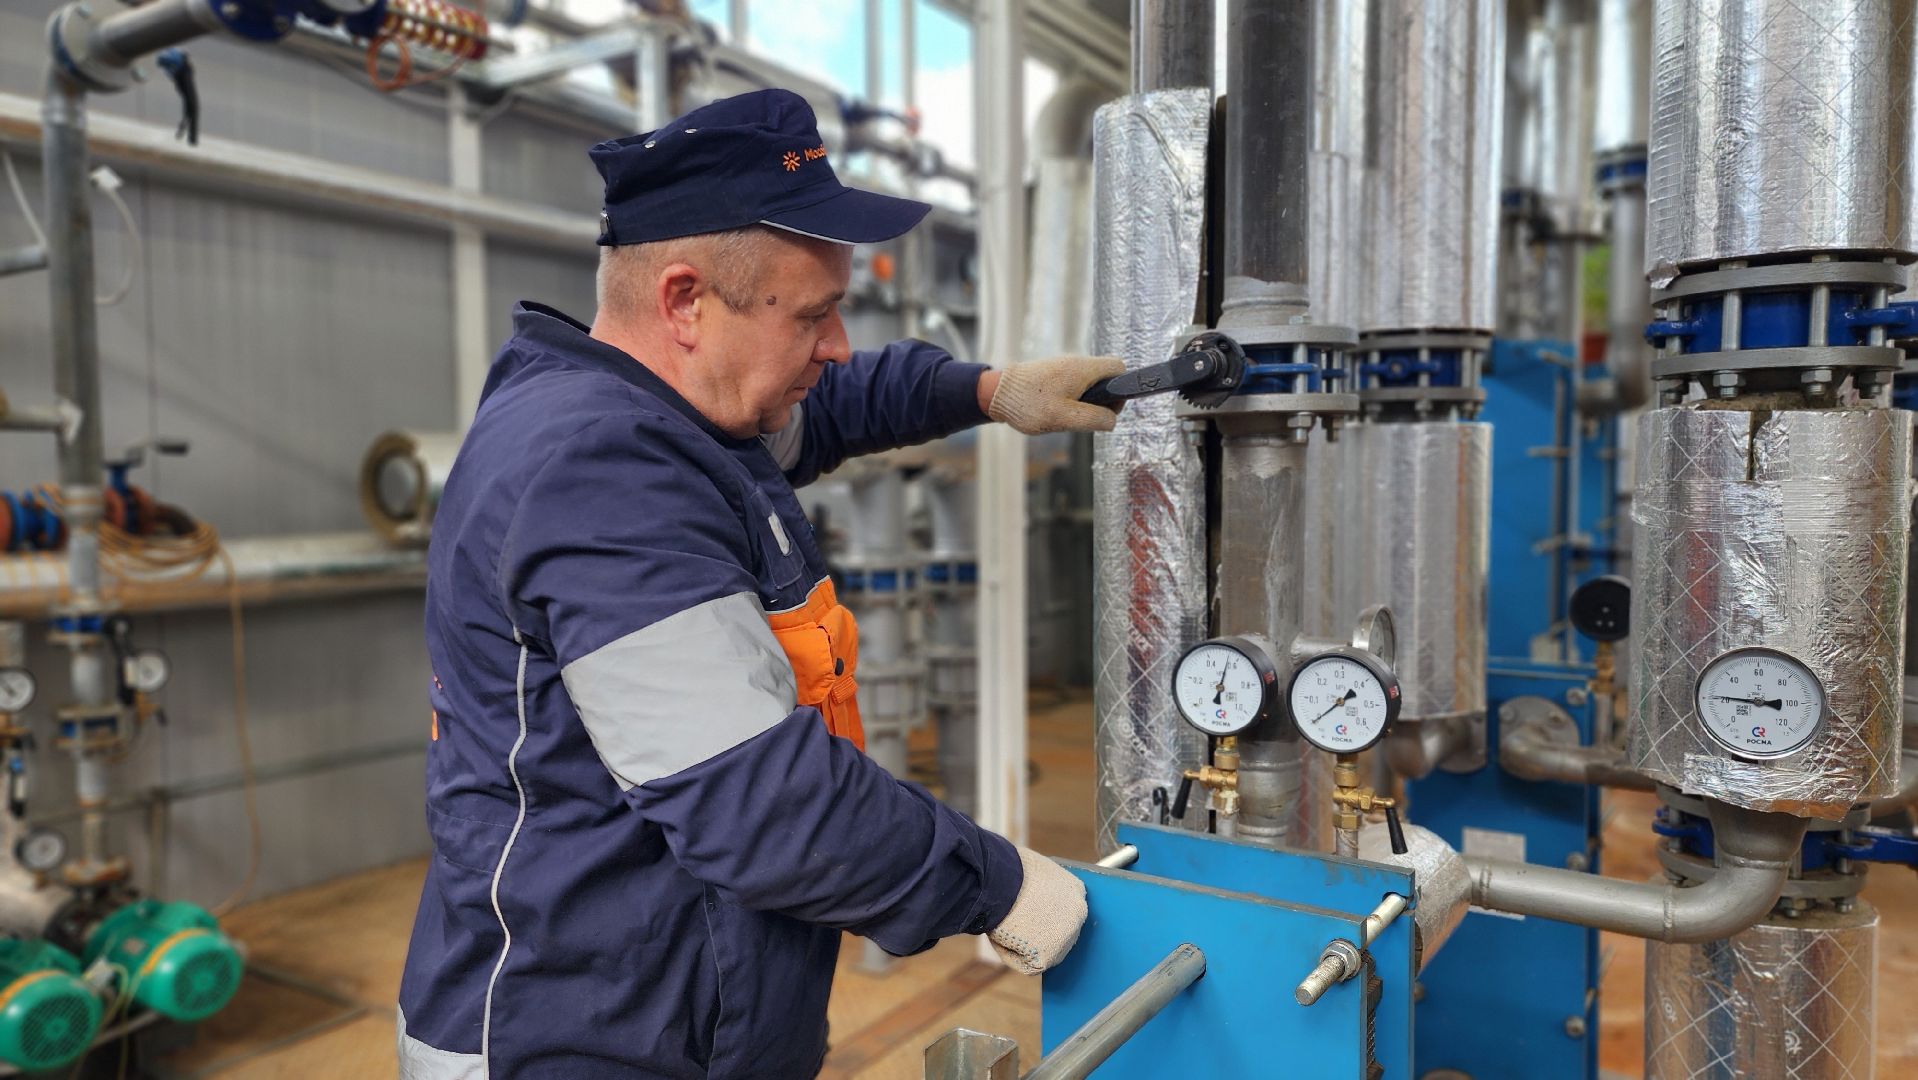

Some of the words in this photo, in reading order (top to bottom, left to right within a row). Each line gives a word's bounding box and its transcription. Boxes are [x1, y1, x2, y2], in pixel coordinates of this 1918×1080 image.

[1207, 660, 1216, 668] 0,4
[1335, 670, 1345, 679] 0,3
[1317, 678, 1327, 686] 0,2
[1354, 680, 1365, 689] 0,4
[1309, 696, 1319, 704] 0,1
[1364, 700, 1374, 708] 0,5
[1720, 696, 1730, 704] 20
[1355, 717, 1367, 726] 0,6
[1776, 718, 1788, 726] 120
